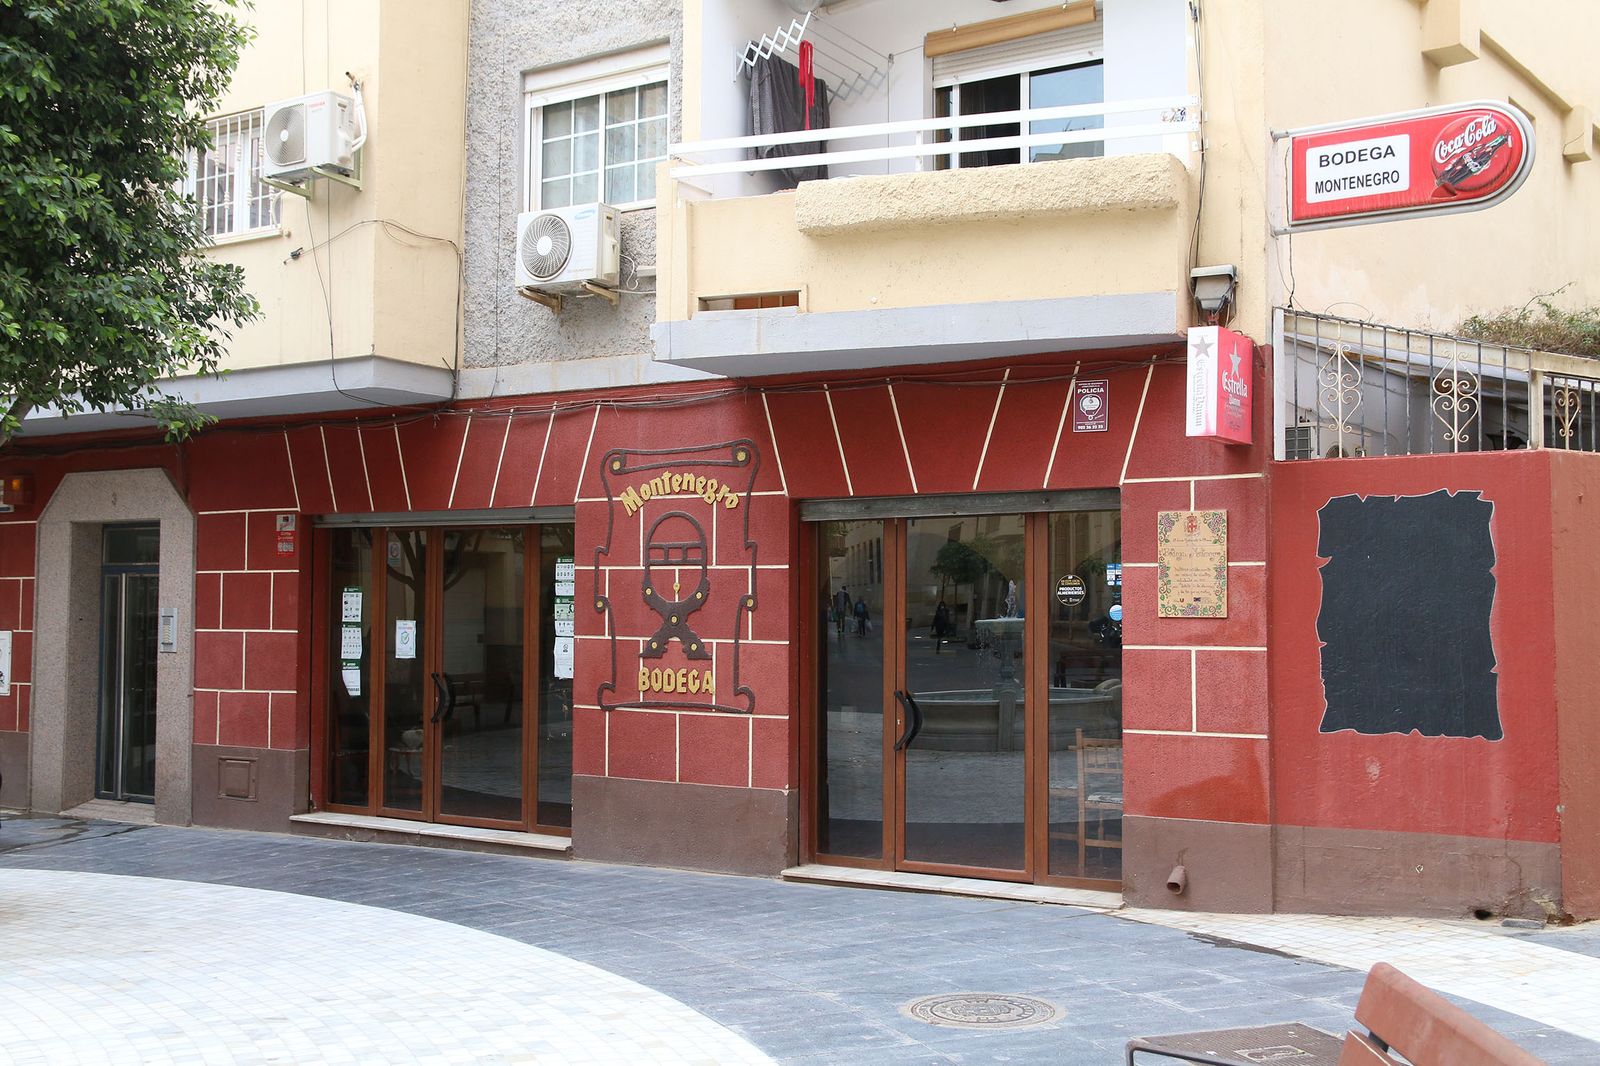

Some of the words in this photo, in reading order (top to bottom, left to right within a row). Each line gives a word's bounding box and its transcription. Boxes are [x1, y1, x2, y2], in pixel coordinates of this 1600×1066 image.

[1434, 112, 1497, 165] Coca-Cola
[1319, 144, 1396, 168] BODEGA
[1314, 169, 1400, 195] MONTENEGRO
[1222, 369, 1248, 398] Estrella
[620, 470, 739, 517] Montenegro
[638, 666, 716, 695] BODEGA
